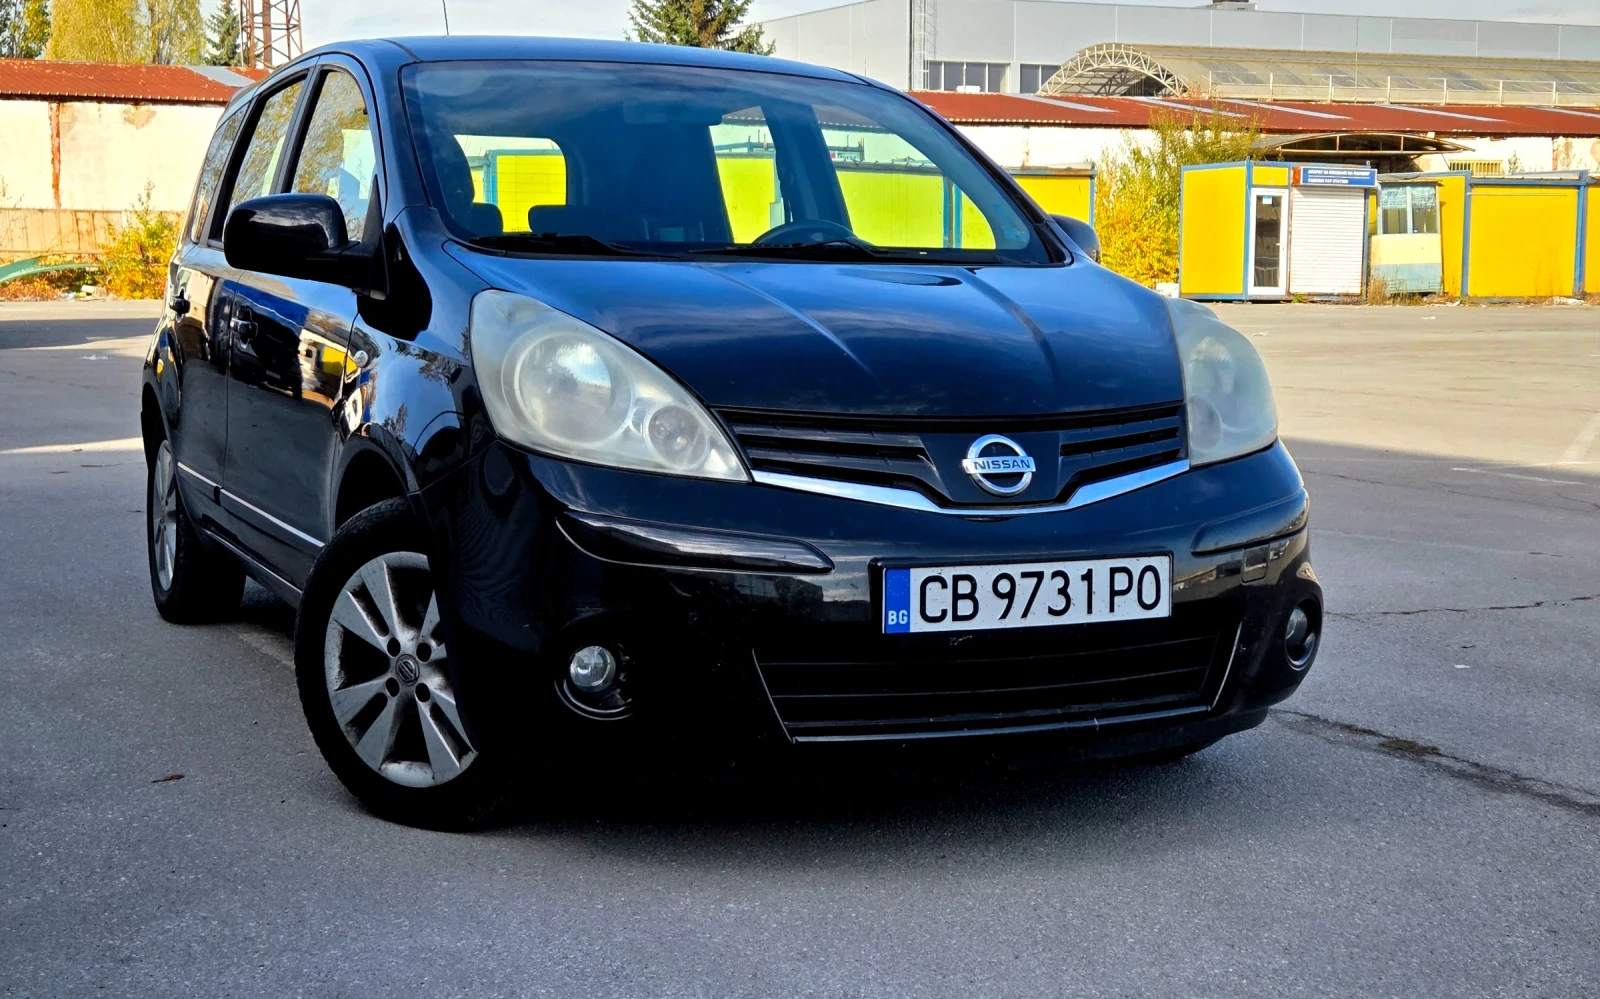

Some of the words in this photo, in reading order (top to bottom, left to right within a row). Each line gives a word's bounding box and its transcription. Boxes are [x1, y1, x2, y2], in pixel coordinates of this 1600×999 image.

[973, 459, 1030, 470] NISSAN
[919, 574, 980, 624] CB
[991, 568, 1094, 621] 9731
[1109, 564, 1162, 613] PO
[887, 610, 908, 625] BG
